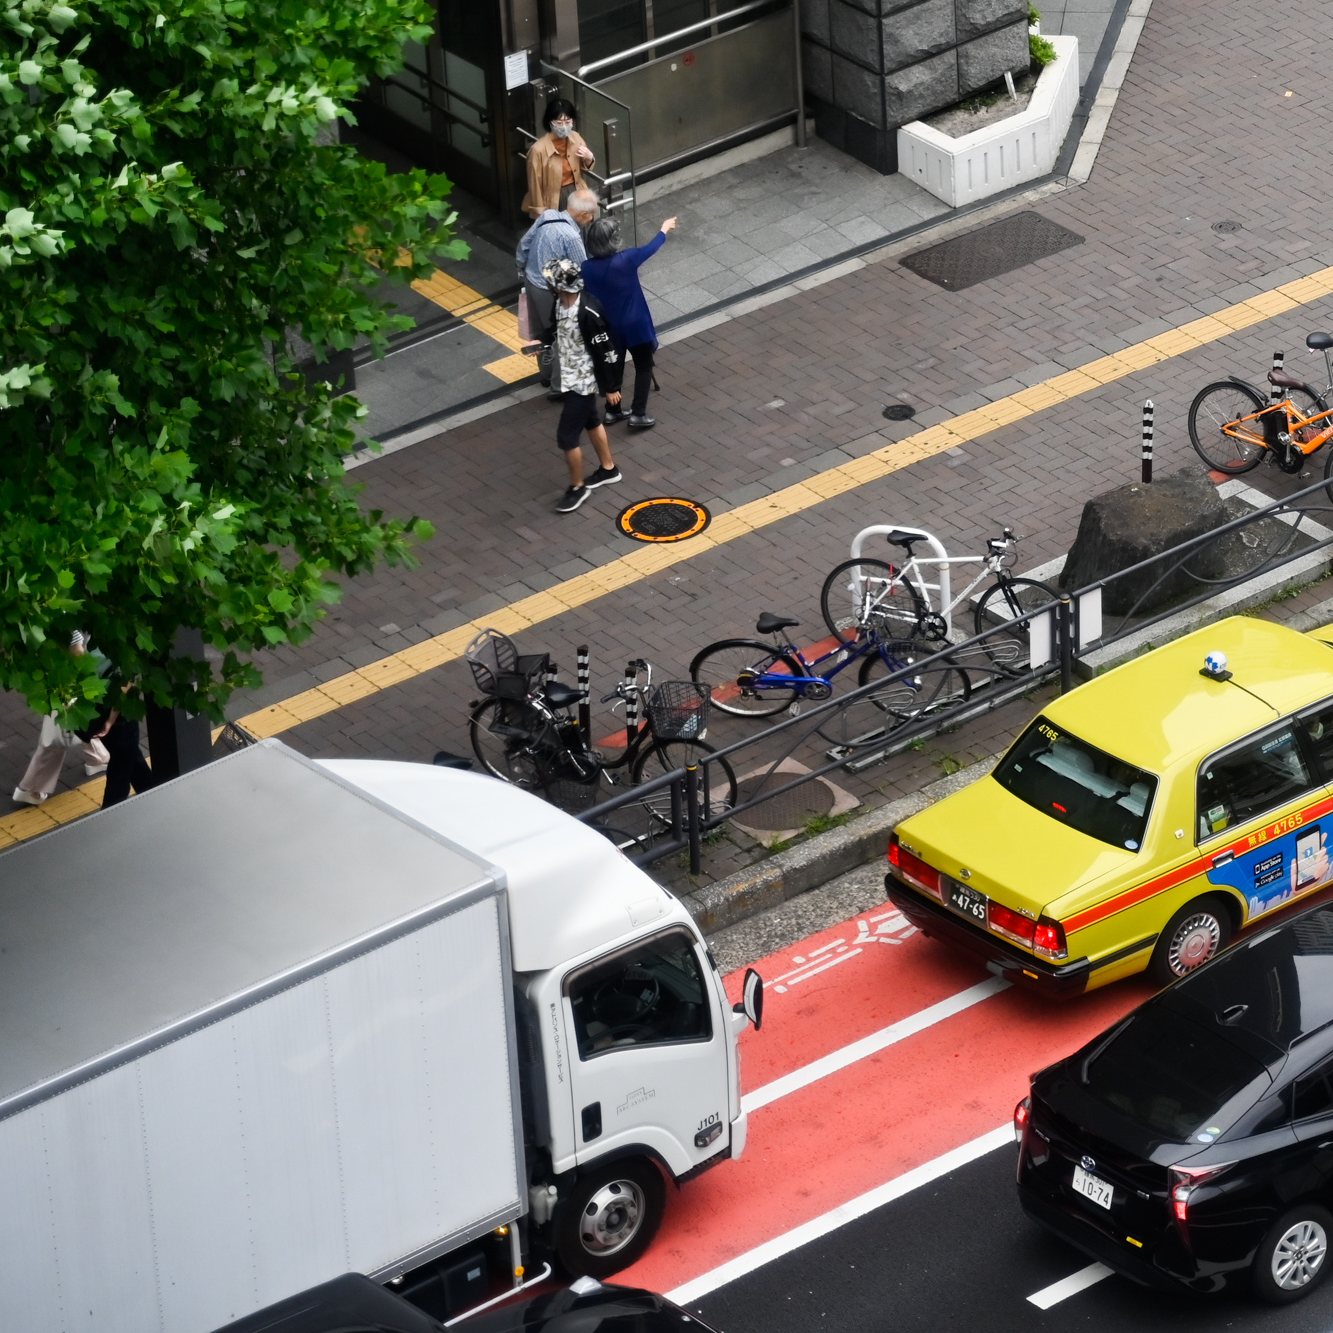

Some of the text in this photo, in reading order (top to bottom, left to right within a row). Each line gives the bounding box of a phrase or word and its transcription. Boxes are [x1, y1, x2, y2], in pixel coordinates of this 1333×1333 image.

[1038, 724, 1059, 741] 4765
[1248, 813, 1303, 847] 無線 4765
[1261, 862, 1270, 872] App
[957, 894, 985, 920] 47-65
[697, 1112, 720, 1131] J101
[1082, 1178, 1110, 1206] 10-74
